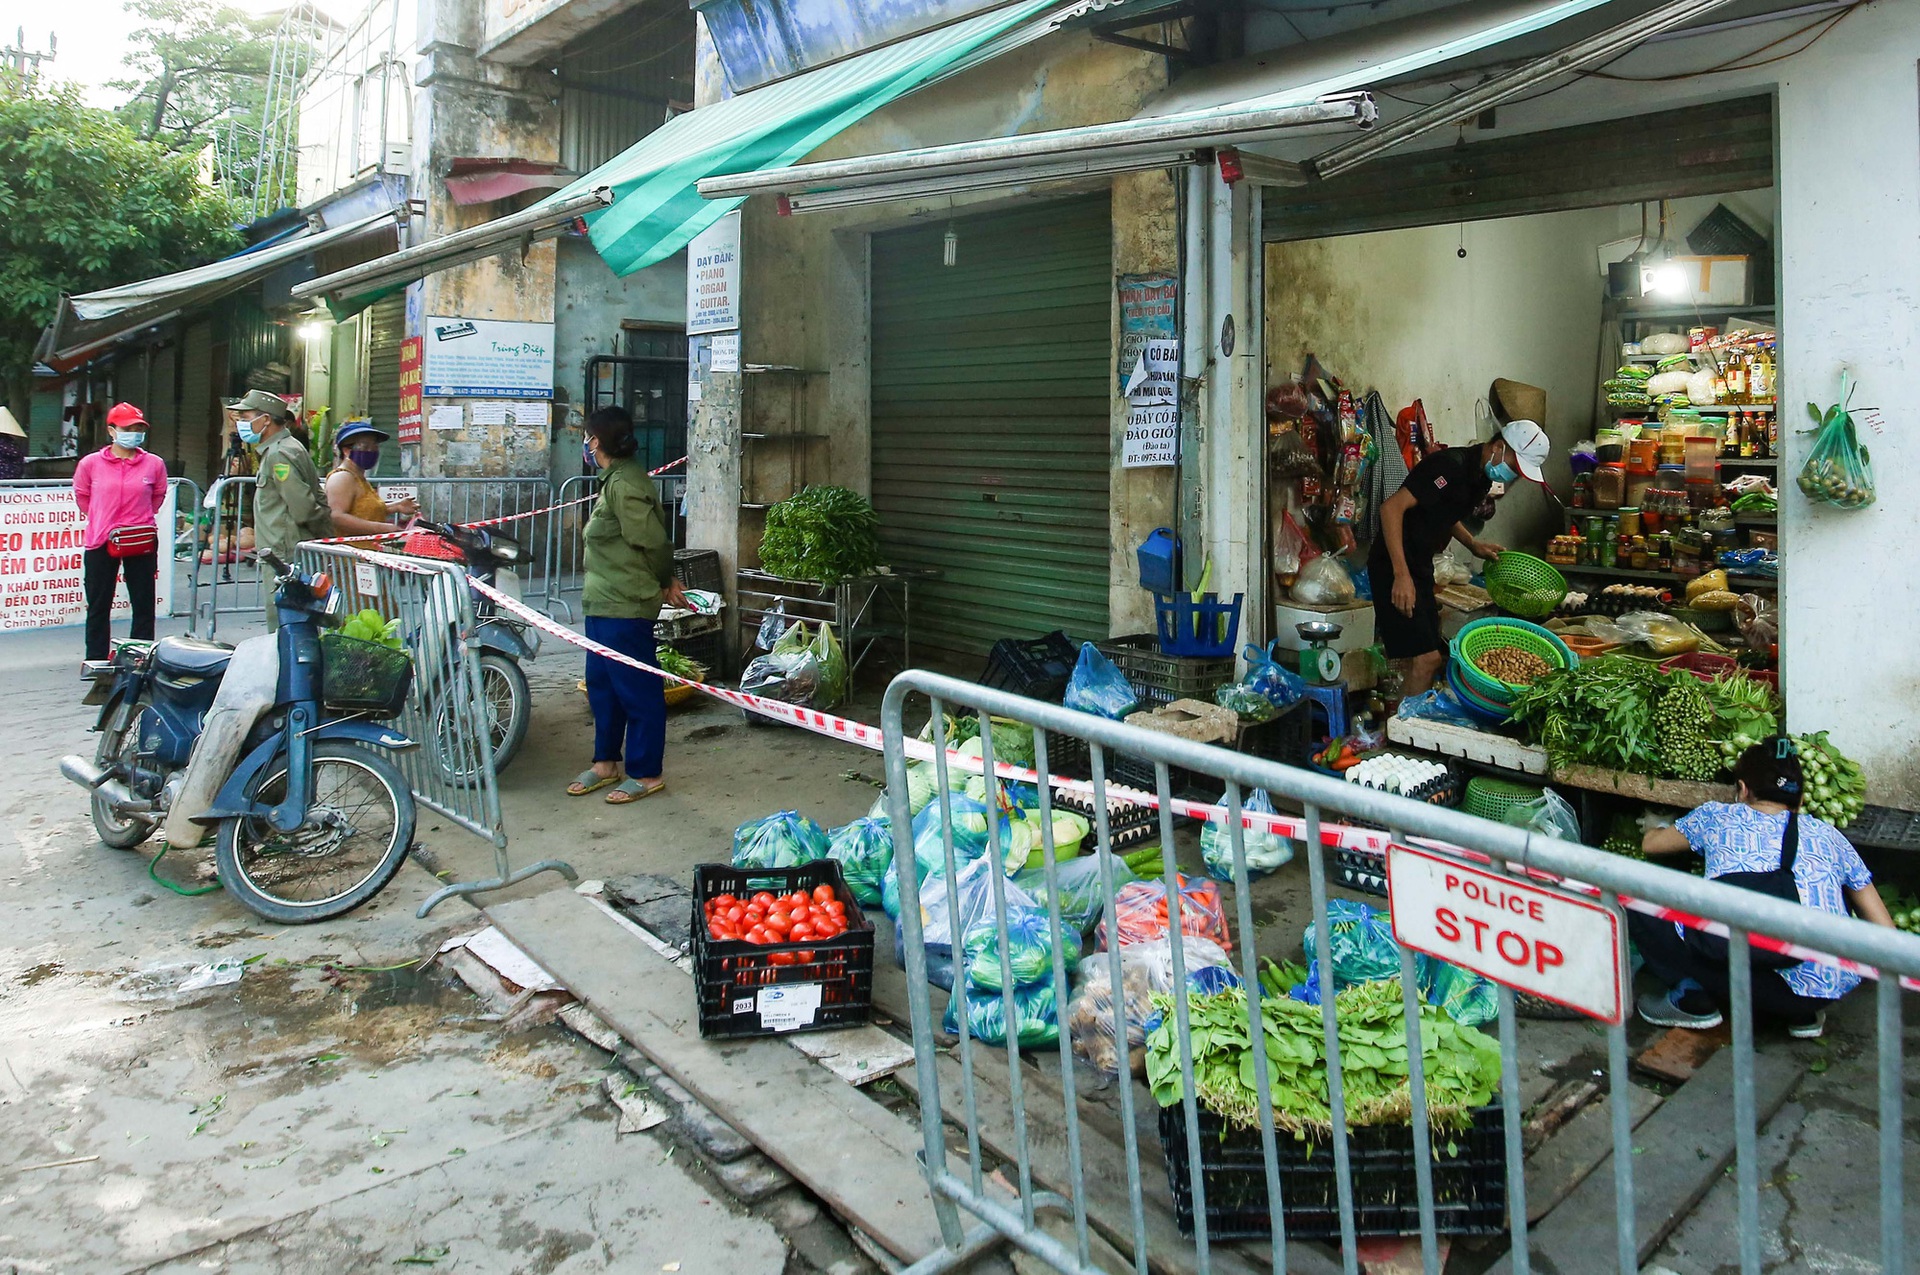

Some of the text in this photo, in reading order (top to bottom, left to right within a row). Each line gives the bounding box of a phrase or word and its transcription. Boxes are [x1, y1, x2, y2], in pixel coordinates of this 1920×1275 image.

[697, 251, 734, 268] DẠY ĐÀN:
[700, 267, 725, 281] PIANO
[700, 281, 727, 295] ORGAN
[700, 296, 730, 309] GUITAR.
[523, 342, 546, 357] Điệp
[1150, 345, 1161, 361] CÓ
[1135, 410, 1154, 425] ĐÂY
[1155, 409, 1169, 424] CÓ
[1126, 424, 1176, 441] ĐÀO GIỐ
[1143, 442, 1170, 450] (Đào ta)
[1128, 454, 1140, 463] ĐT:
[4, 509, 45, 524] CHỐNG
[48, 511, 75, 525] DỊCH
[31, 524, 85, 550] KHẨU
[33, 553, 82, 573] CÔNG
[43, 577, 80, 590] TRANG
[5, 591, 83, 607] ĐẾN 03 TRIỆU
[15, 609, 26, 618] 12
[1445, 873, 1545, 922] POLICE
[1435, 907, 1565, 975] STOP
[735, 1002, 752, 1010] 2033
